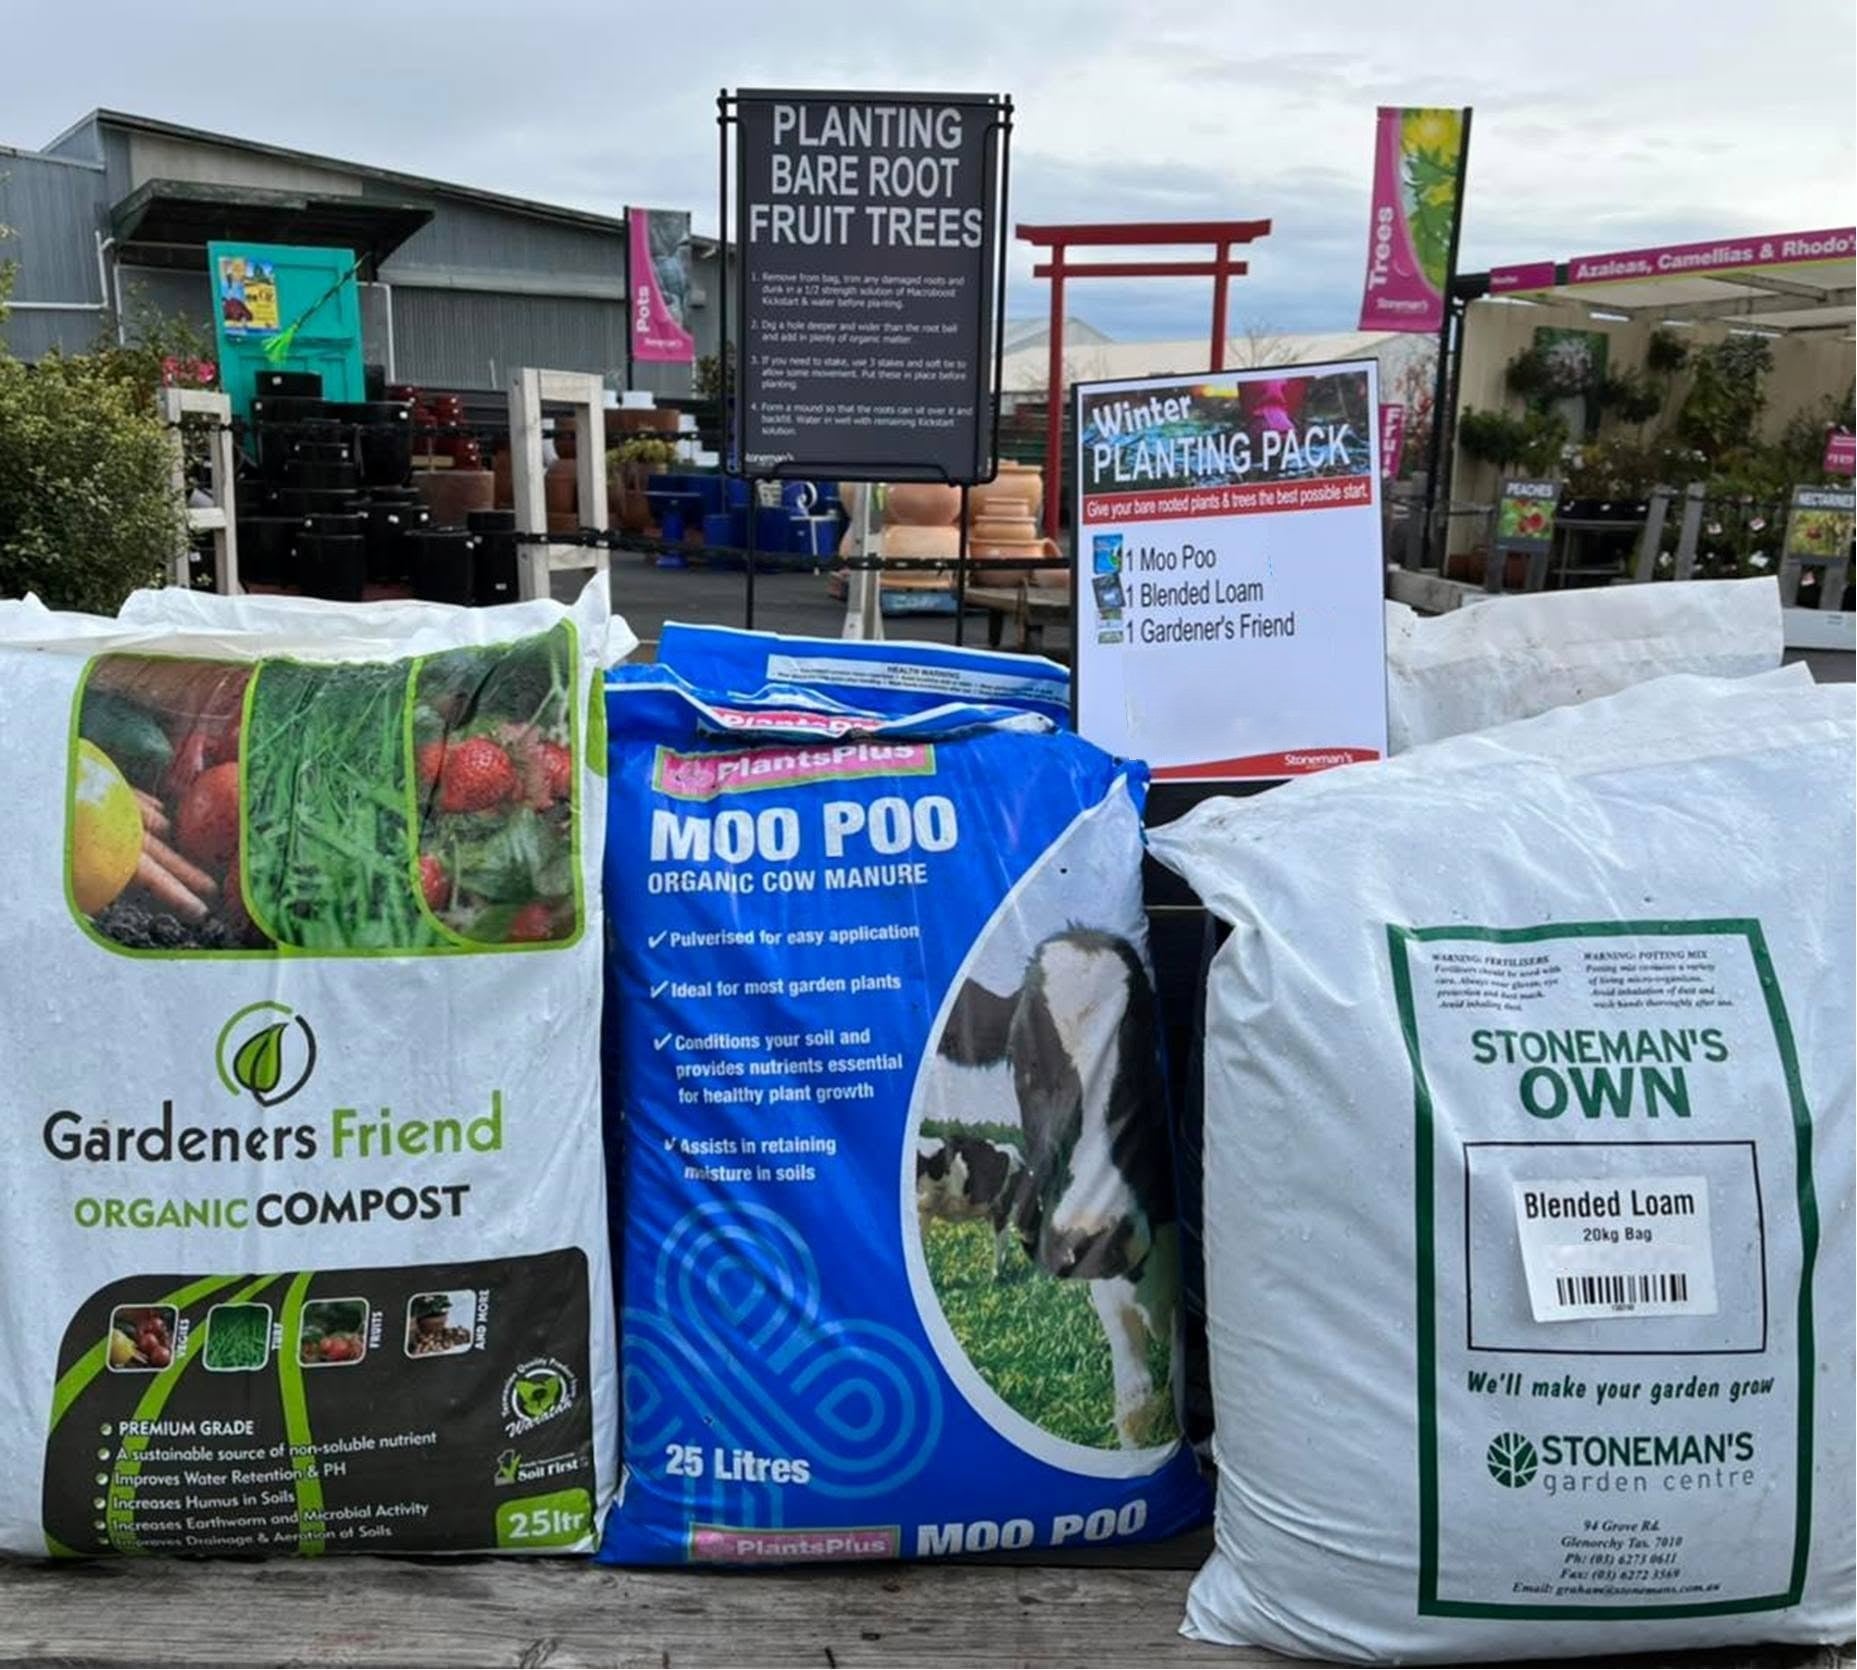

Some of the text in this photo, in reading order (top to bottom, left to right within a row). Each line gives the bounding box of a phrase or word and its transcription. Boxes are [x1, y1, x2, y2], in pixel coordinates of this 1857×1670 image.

[773, 105, 962, 149] PLANTING
[771, 155, 959, 198] BARE ROOT
[750, 204, 982, 248] FRUIT TREES
[1368, 206, 1393, 291] Trees
[1576, 259, 1652, 280] Azaleas,
[1657, 246, 1752, 270] Camellias
[1760, 244, 1774, 259] &
[762, 271, 798, 282] Remove
[799, 272, 820, 283] from
[843, 274, 861, 284] trim
[863, 276, 880, 287] any
[881, 275, 922, 287] damaged
[923, 276, 946, 286] roots
[948, 276, 965, 286] and
[636, 285, 650, 333] Pots
[1092, 391, 1193, 439] Winter
[1093, 423, 1351, 484] PLANTING PACK
[1087, 482, 1369, 520] Give your bare rooted plants & trees the best possible start.
[1506, 482, 1553, 498] PEACHES
[1126, 544, 1216, 572] 1 Moo Poo
[1126, 579, 1264, 608] 1 Blended Loam
[1126, 611, 1295, 644] 1 Gardener's Friend
[887, 665, 961, 680] HEALTH WARNING
[717, 743, 915, 781] PlantsPlus
[650, 795, 958, 864] MOO POO
[648, 863, 928, 894] ORGANIC COW MANURE
[670, 924, 920, 948] Pulverised for easy application
[1638, 950, 1685, 960] POTTING
[1687, 950, 1708, 960] MIX
[671, 974, 902, 998] Ideal for most garden plants
[675, 1027, 871, 1051] Conditions your soil and
[1471, 1028, 1729, 1064] STONEMAN'S
[676, 1053, 903, 1080] provides nutrients essential
[678, 1082, 875, 1106] for healthy plant growth
[1519, 1066, 1692, 1119] OWN
[43, 1089, 502, 1163] Gardeners Friend
[680, 1135, 837, 1155] Assists in retaining
[684, 1164, 816, 1182] moisture in soils
[74, 1184, 471, 1229] ORGANIC COMPOST
[1524, 1189, 1695, 1218] Blended Loam
[1583, 1226, 1653, 1243] 20kg Bag
[369, 1311, 383, 1349] FRUITS
[475, 1289, 490, 1350] AND MORE
[271, 1322, 283, 1350] TURF
[1467, 1370, 1775, 1405] We'll make your garden grow
[119, 1419, 255, 1436] PREMIUM GRADE
[116, 1431, 437, 1461] A sustainable source of non-soluble nutrient
[1542, 1432, 1754, 1467] STONEMAN'S
[114, 1462, 346, 1487] Improves Water Retention & PH
[517, 1464, 544, 1482] Soil
[547, 1460, 578, 1477] First
[665, 1443, 810, 1485] 25 Litres
[1543, 1467, 1755, 1496] garden centre
[113, 1490, 294, 1510] Increases Humus in Soils
[113, 1502, 429, 1532] Increases Earthworm and Microbial Activity
[508, 1508, 585, 1539] 25ltr
[916, 1498, 1148, 1556] MOO POO
[1583, 1520, 1599, 1531] 94
[1602, 1520, 1638, 1532] Grove
[185, 1524, 392, 1547] Drainage & Aeration of Soils
[736, 1533, 886, 1557] PlantsPlus
[1561, 1536, 1624, 1551] Glenorchy
[1656, 1536, 1683, 1548] 7010
[1590, 1553, 1614, 1565] (03)
